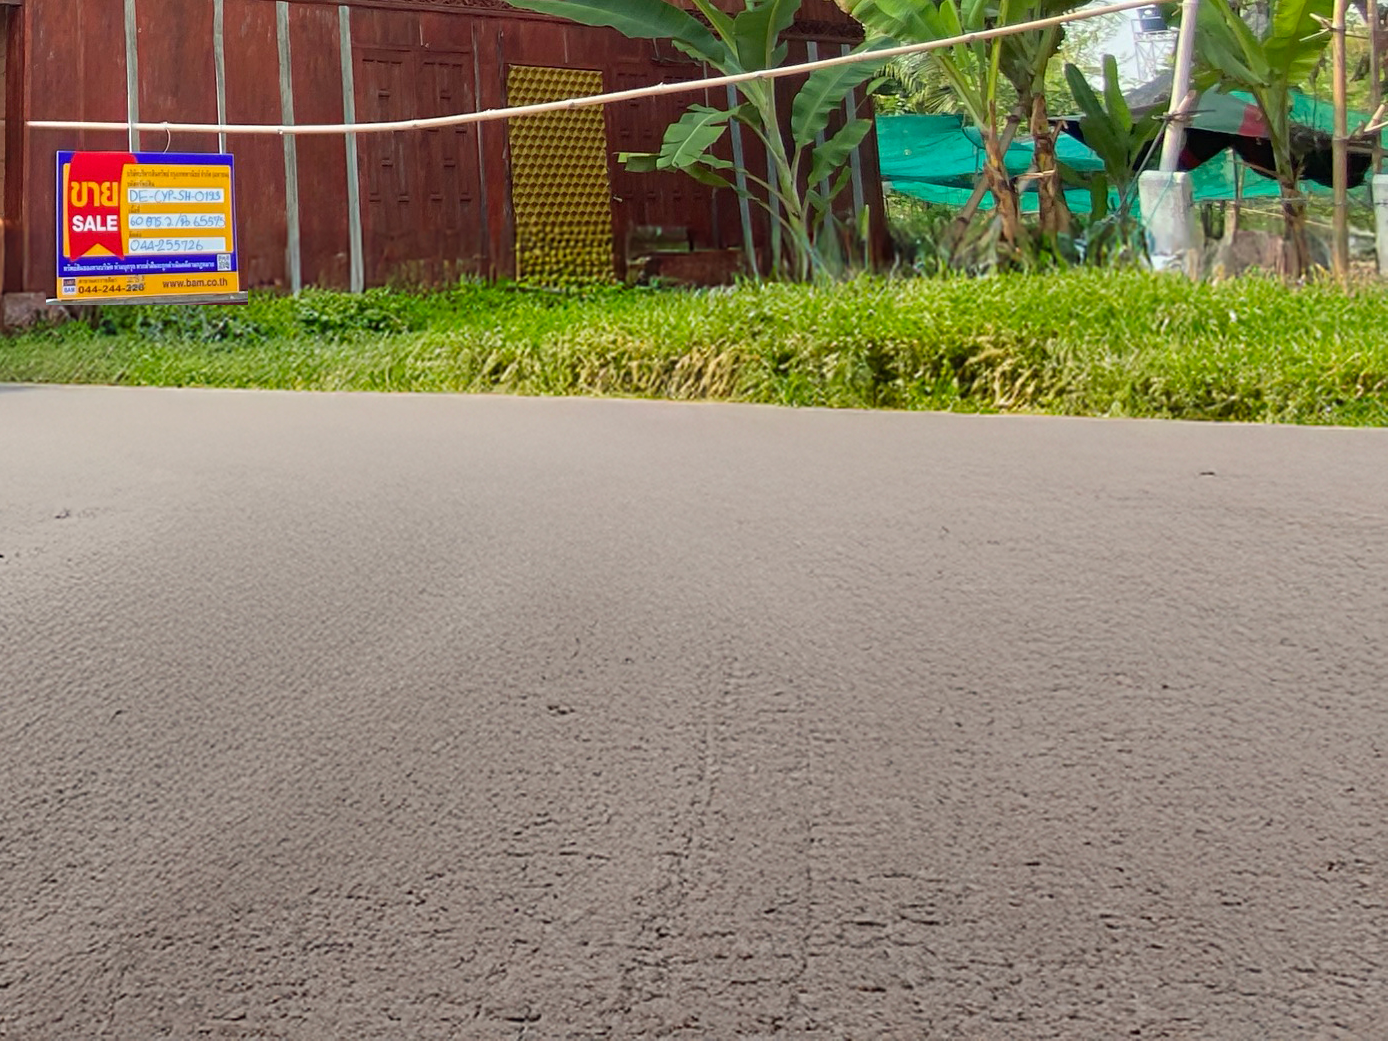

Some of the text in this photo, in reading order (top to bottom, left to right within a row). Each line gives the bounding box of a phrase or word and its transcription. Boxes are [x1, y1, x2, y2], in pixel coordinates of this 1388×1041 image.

[71, 181, 119, 207] ขาย
[72, 214, 119, 232] SALE
[162, 277, 228, 288] www.bam.co.th
